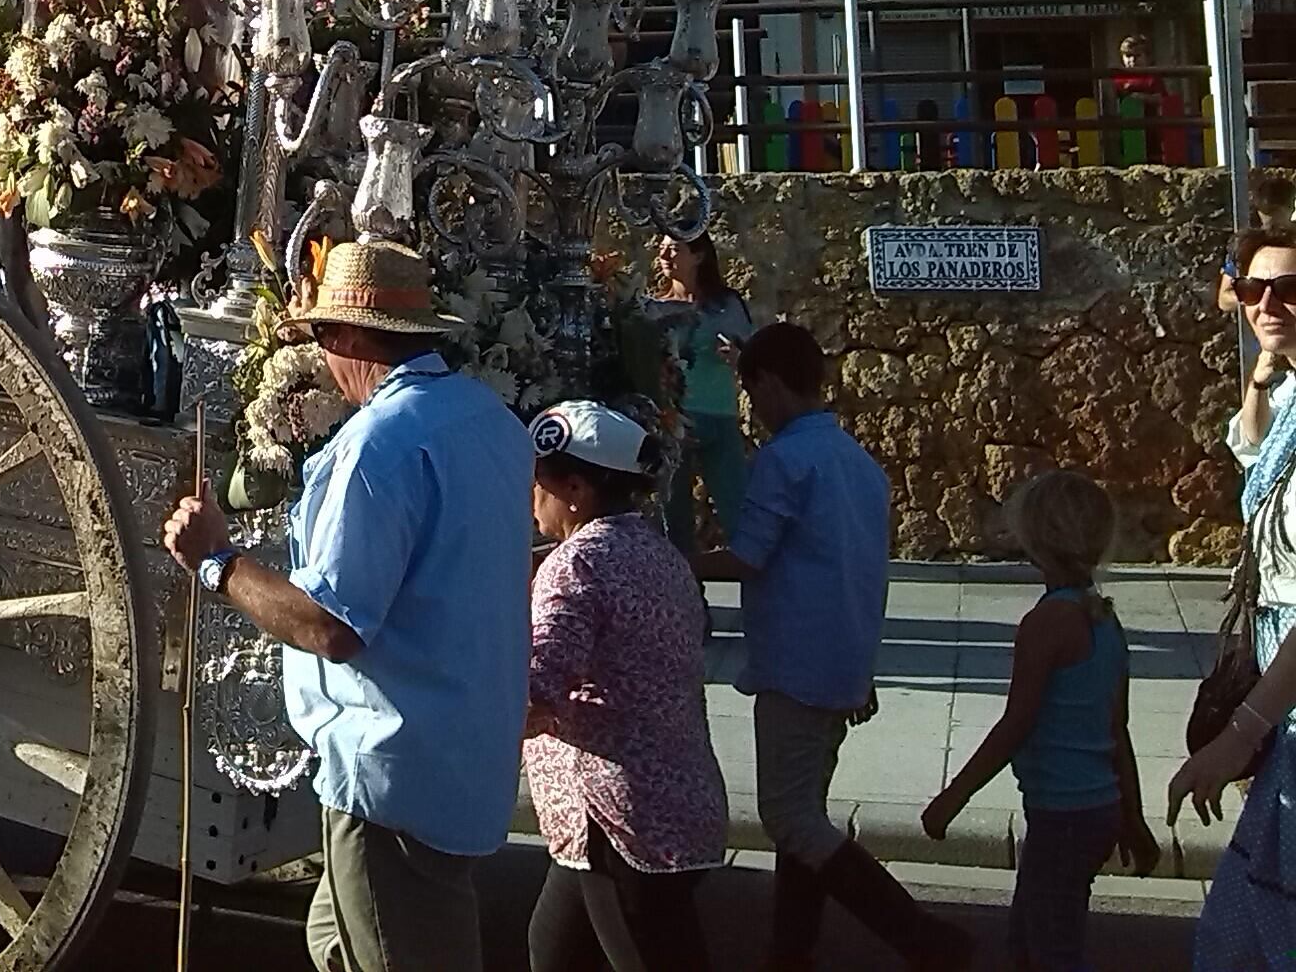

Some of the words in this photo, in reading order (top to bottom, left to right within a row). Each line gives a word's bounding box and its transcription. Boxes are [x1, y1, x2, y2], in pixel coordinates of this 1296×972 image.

[944, 243, 989, 258] TREN
[996, 243, 1019, 258] DE
[888, 261, 920, 278] LOS
[927, 261, 1025, 278] PANADEROS
